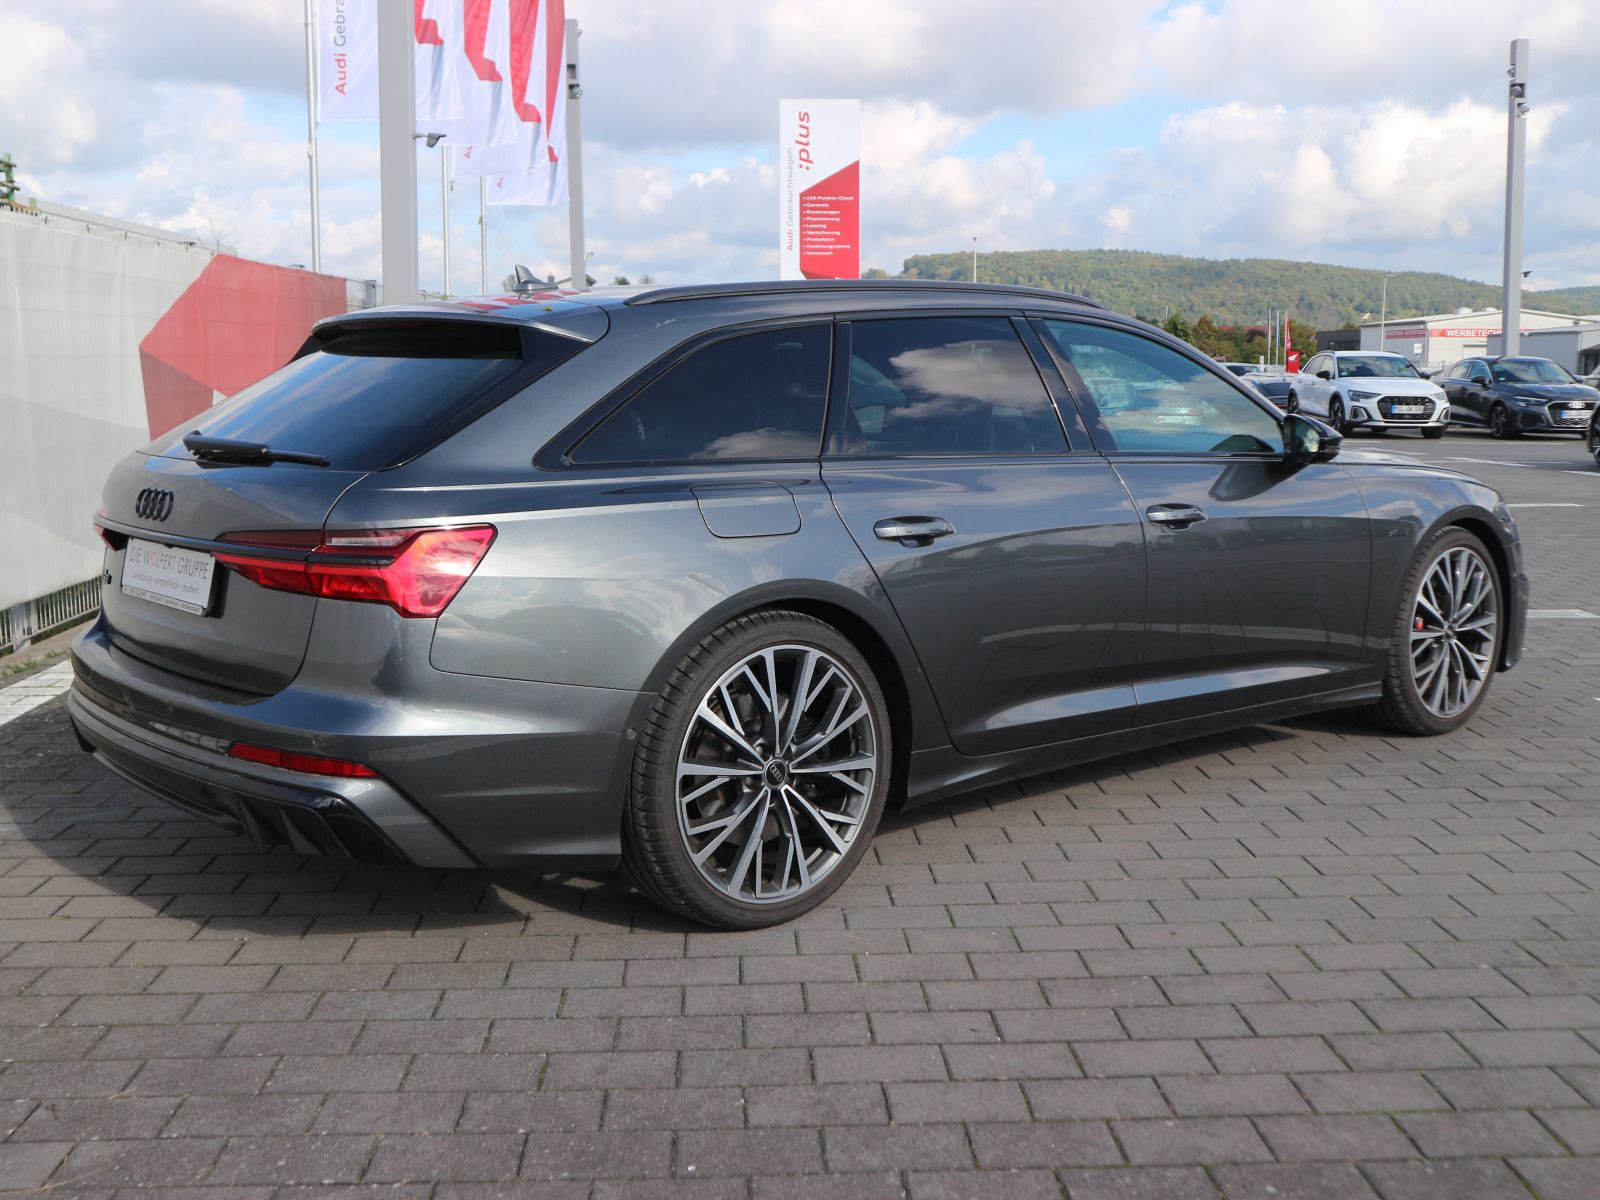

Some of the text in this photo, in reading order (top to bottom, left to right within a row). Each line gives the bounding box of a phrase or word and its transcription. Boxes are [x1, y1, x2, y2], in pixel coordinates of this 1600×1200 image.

[334, 53, 347, 95] Audi
[795, 111, 814, 170] :plus
[786, 147, 794, 227] Gebrauchtwagen
[129, 546, 209, 579] DIE WOLFERT GRUPPE
